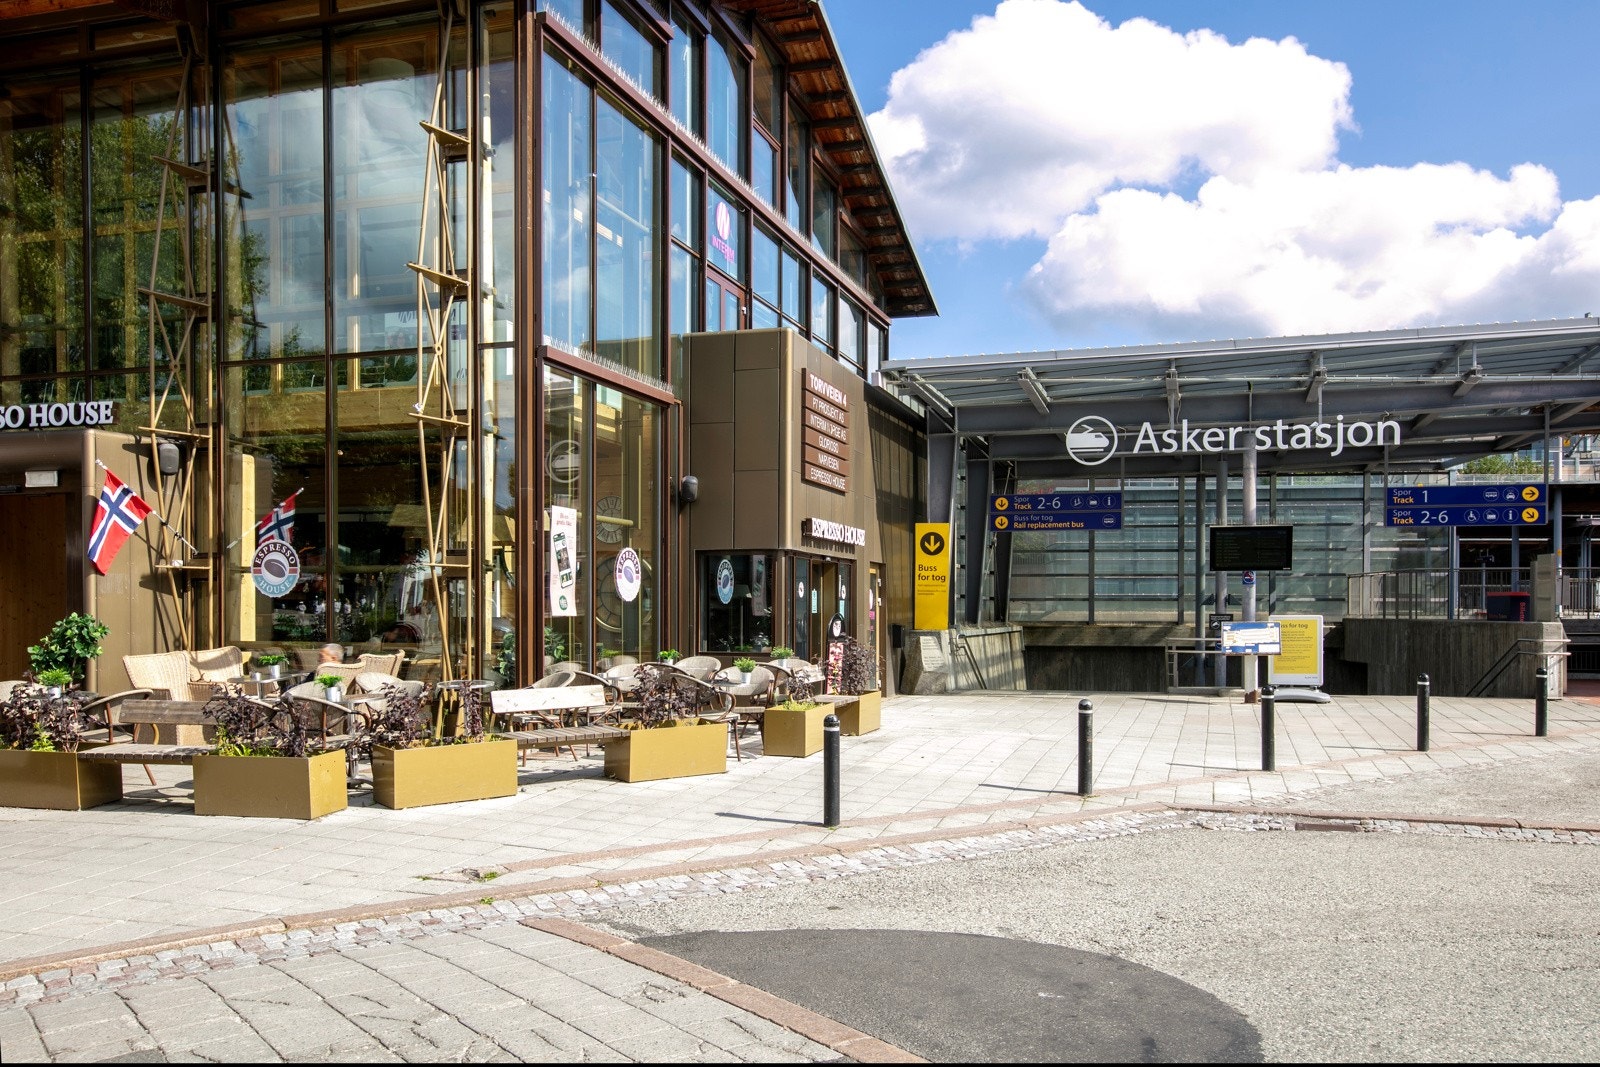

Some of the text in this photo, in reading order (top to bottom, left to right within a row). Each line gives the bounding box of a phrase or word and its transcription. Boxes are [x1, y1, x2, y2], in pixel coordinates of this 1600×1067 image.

[810, 373, 843, 404] TORVVEIEN
[29, 400, 114, 427] HOUSE
[818, 400, 839, 420] PROSJEKT
[839, 412, 844, 424] AS
[810, 414, 827, 432] INTERIM
[841, 429, 847, 441] AS
[1132, 414, 1400, 456] Asker stasjon
[818, 436, 839, 454] GLORIOSO
[818, 453, 839, 470] NARVESEN
[810, 468, 846, 490] ESPRESSO HOUSE
[1037, 497, 1061, 509] 2-6
[1422, 490, 1428, 503] 1
[1420, 510, 1448, 524] 2-6
[812, 517, 866, 547] ESPRESSO HOUSE
[255, 544, 296, 564] ESPRESSO
[260, 580, 291, 593] HOUSE
[932, 574, 946, 583] tog
